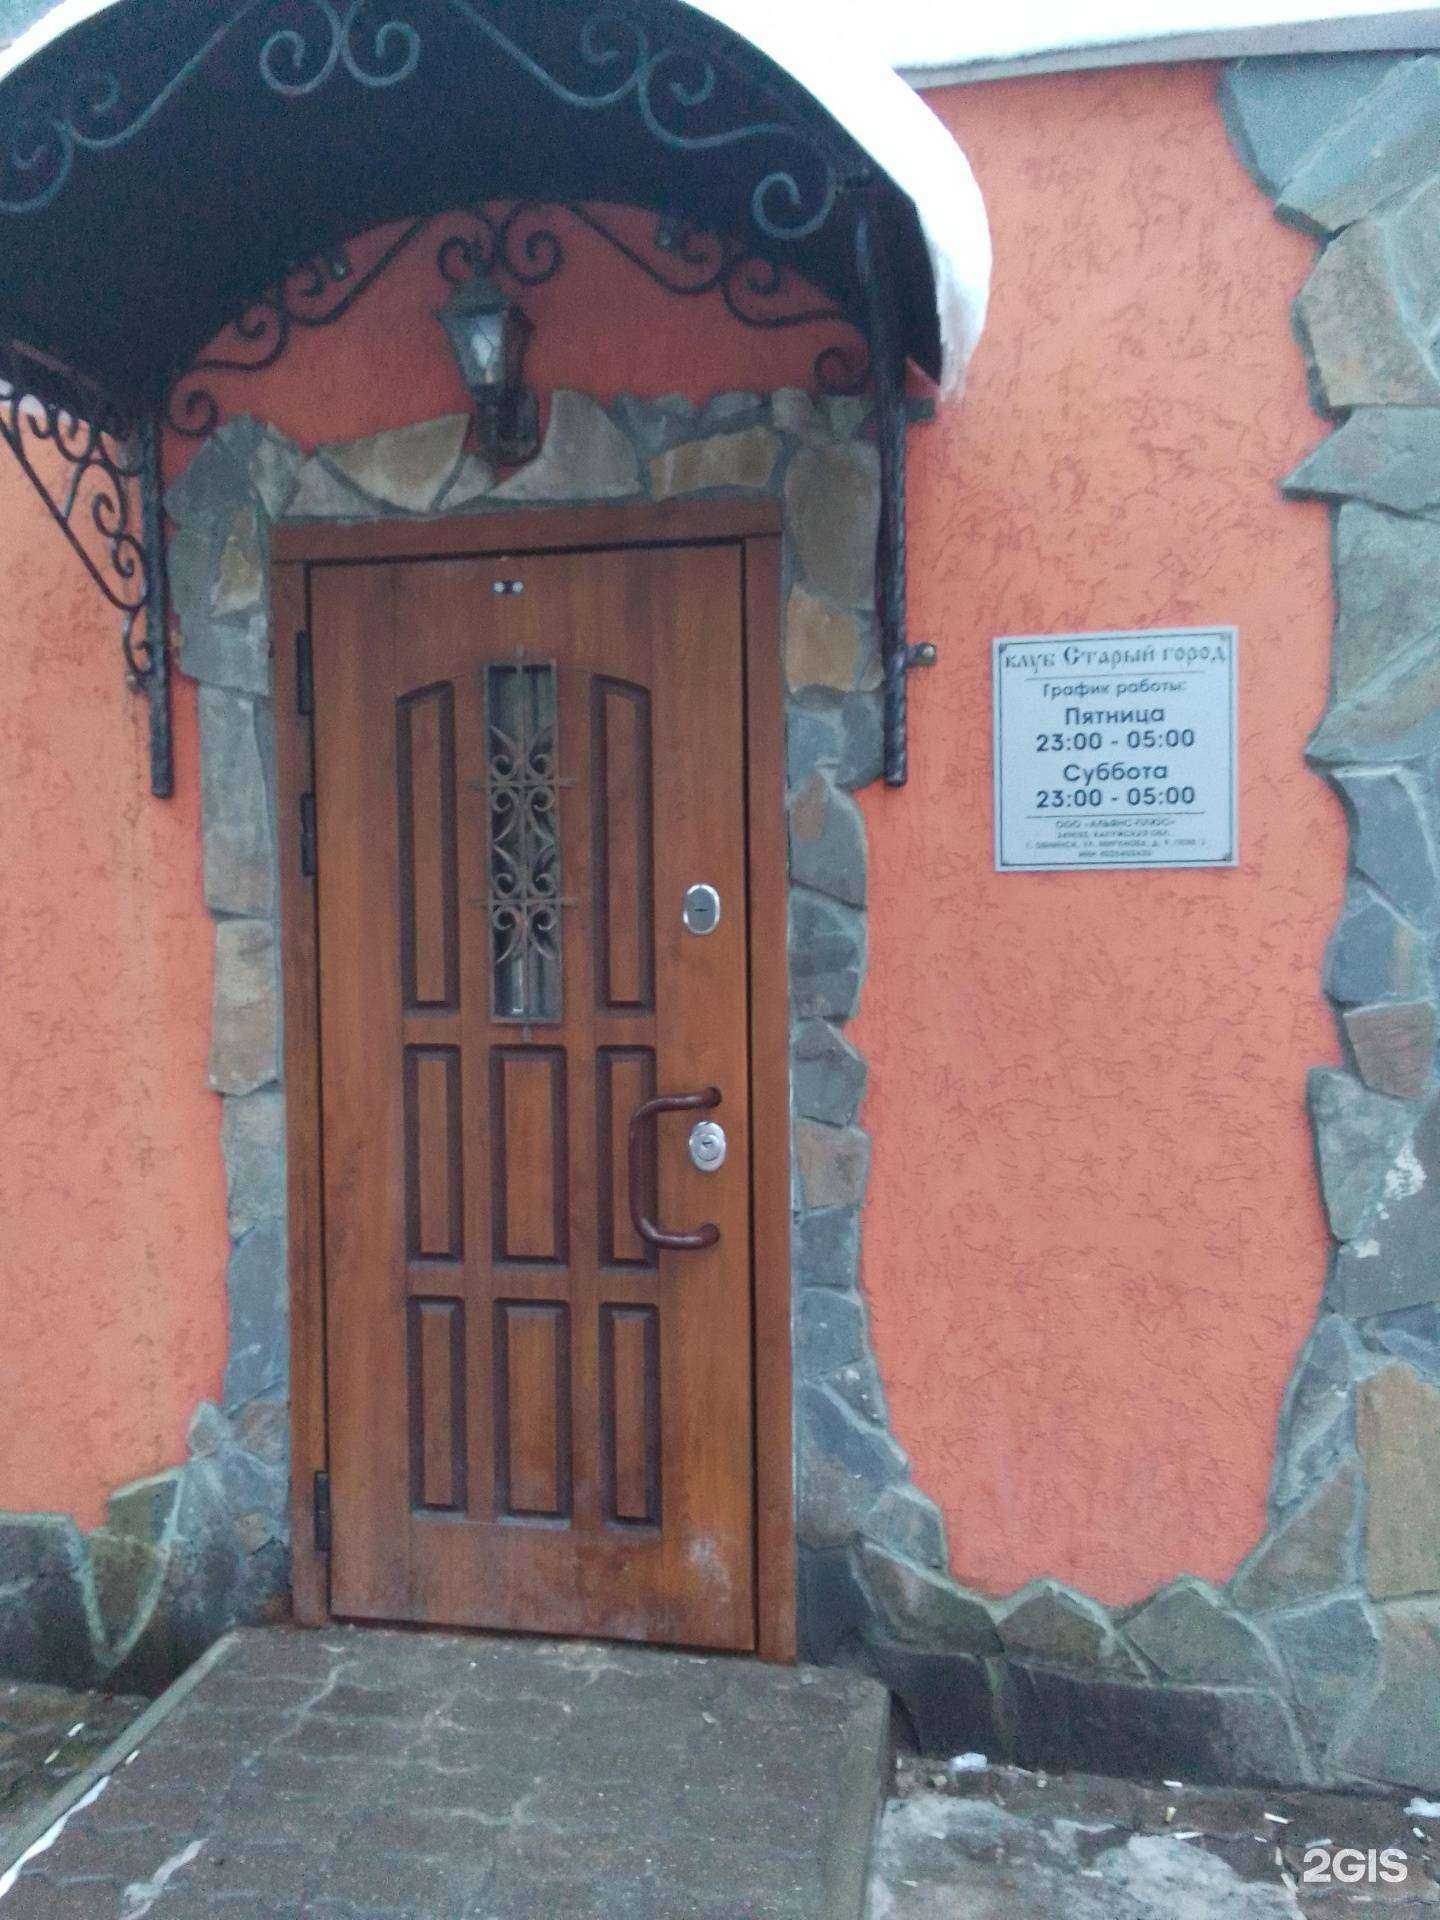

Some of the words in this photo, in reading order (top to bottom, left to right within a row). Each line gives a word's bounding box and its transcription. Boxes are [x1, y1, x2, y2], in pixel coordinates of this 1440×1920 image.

[1064, 645, 1155, 670] Старый
[1043, 681, 1110, 700] График
[1065, 707, 1166, 725] Пятница
[1036, 732, 1103, 752] 23:00
[1126, 729, 1195, 749] 05:00
[1063, 763, 1168, 786] Суббота
[1036, 789, 1103, 808] 23:00
[1126, 786, 1195, 806] 05:00
